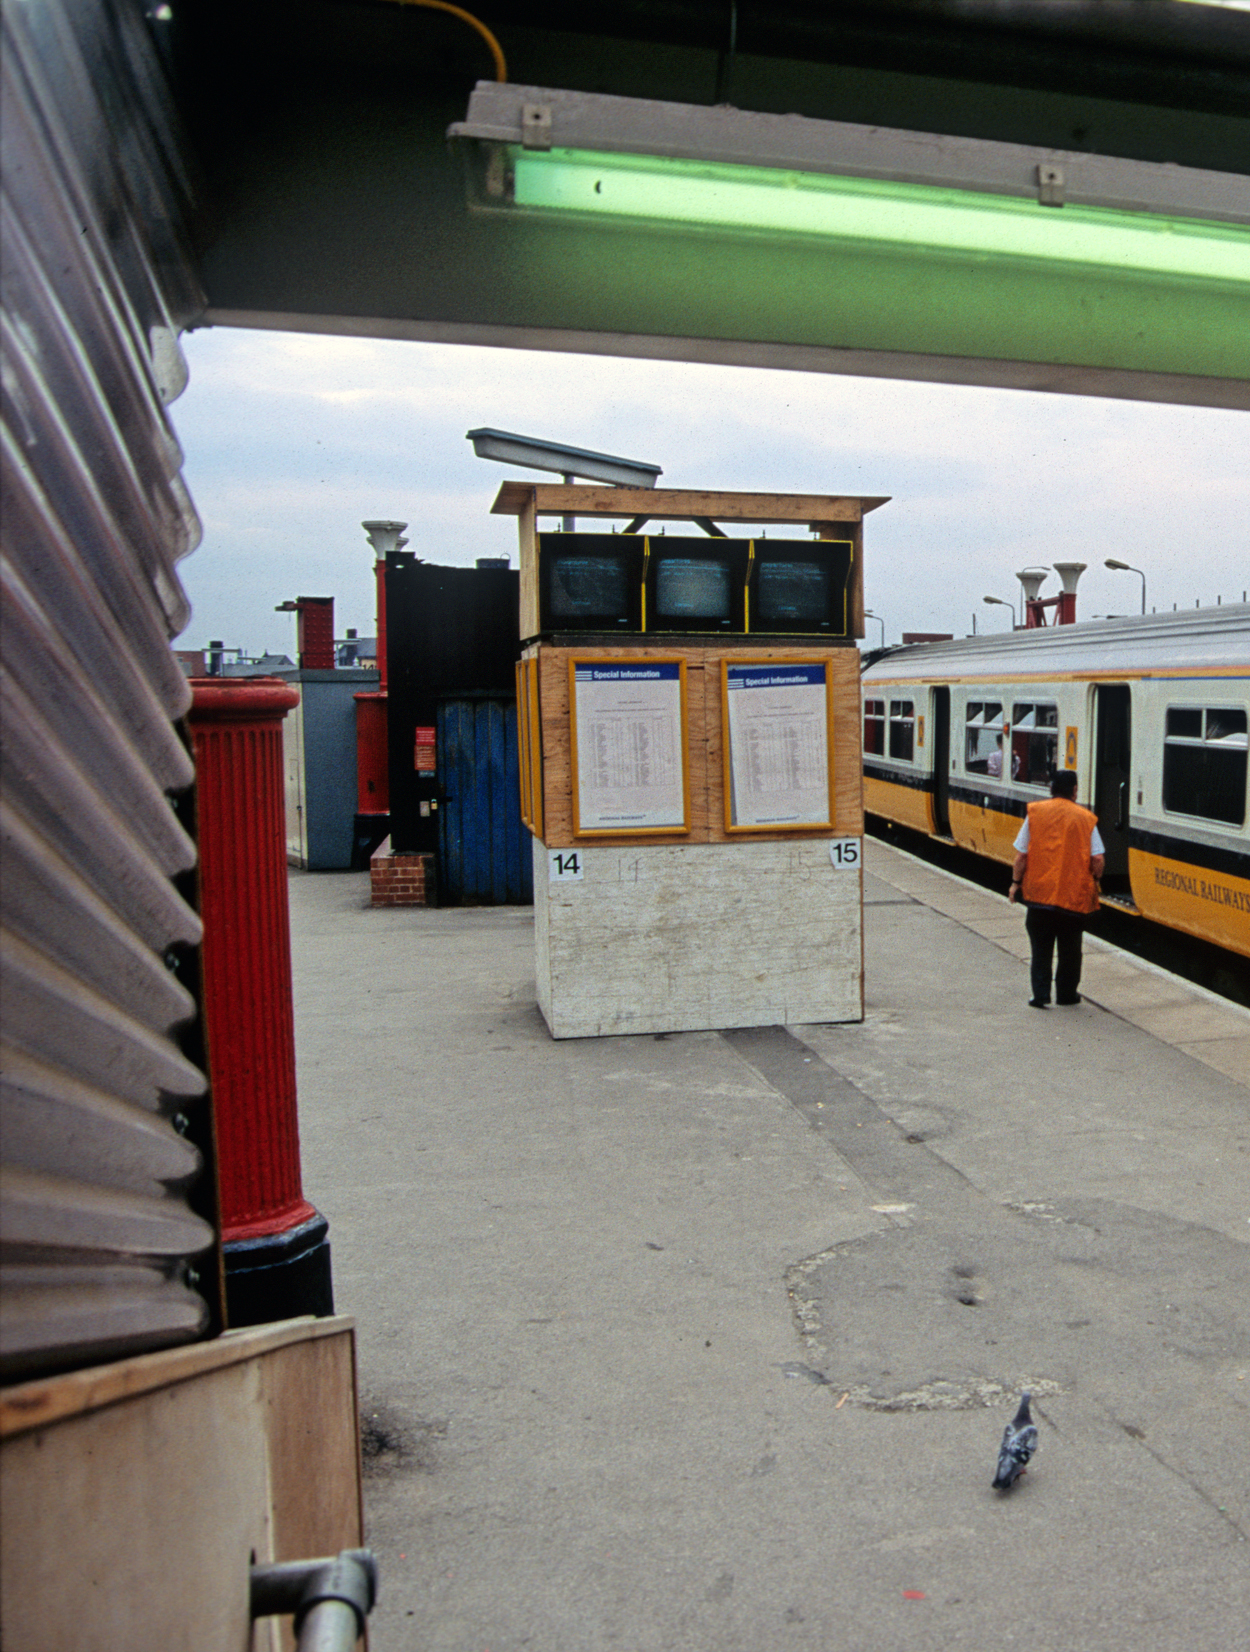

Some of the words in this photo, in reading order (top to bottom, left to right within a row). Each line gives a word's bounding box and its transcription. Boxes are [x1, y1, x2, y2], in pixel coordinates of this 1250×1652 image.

[594, 670, 619, 679] Special
[620, 670, 660, 678] Information
[746, 677, 770, 686] Special
[771, 675, 808, 684] Information
[833, 842, 858, 863] 15
[553, 853, 580, 875] 14
[1154, 867, 1199, 897] REGIONAL
